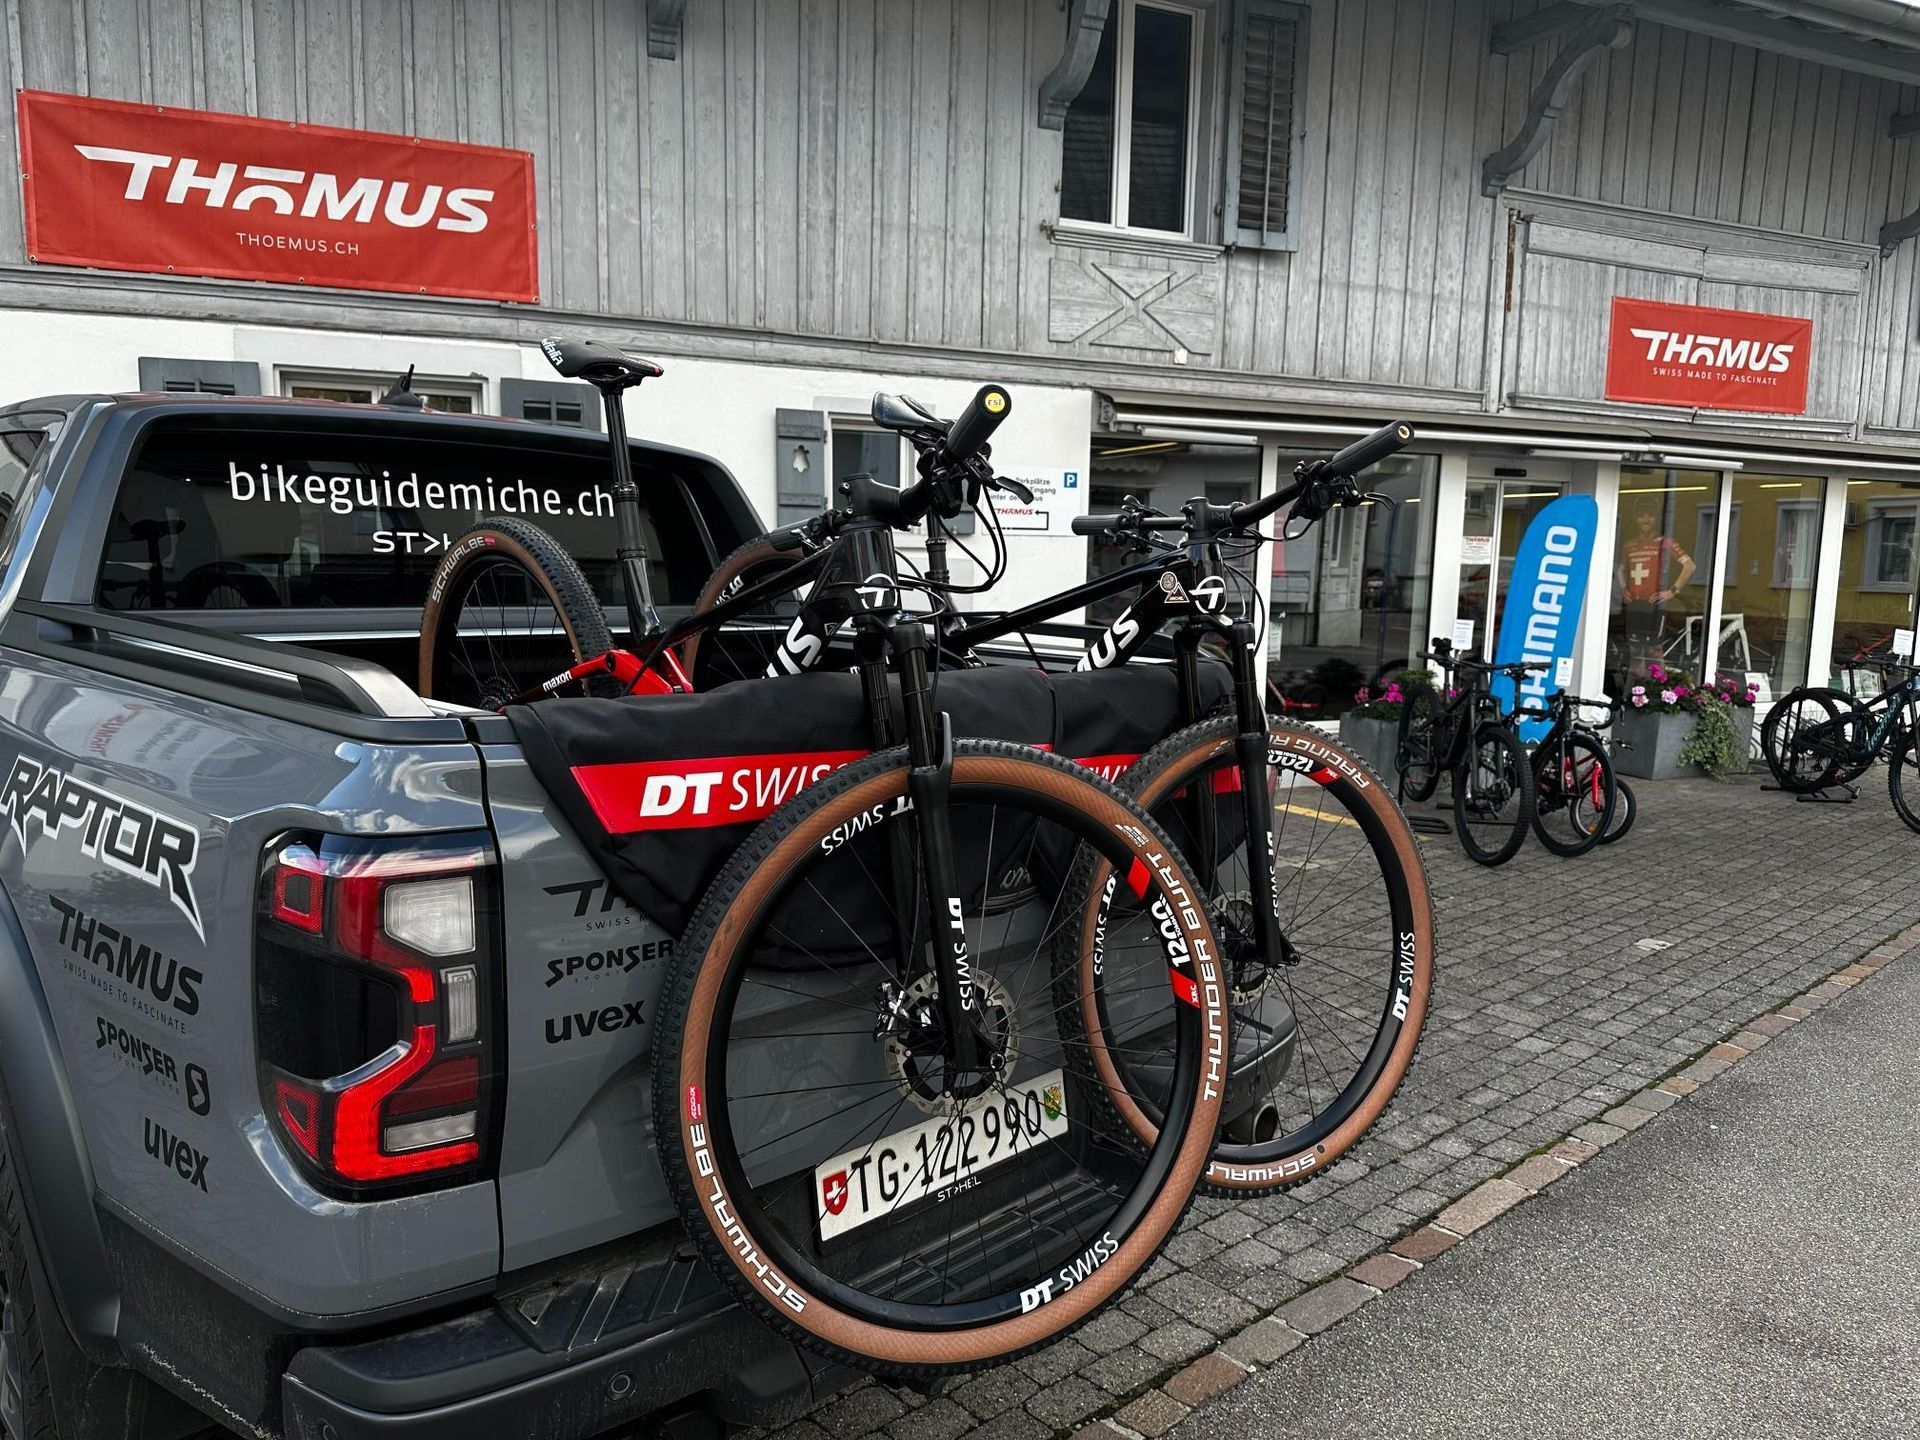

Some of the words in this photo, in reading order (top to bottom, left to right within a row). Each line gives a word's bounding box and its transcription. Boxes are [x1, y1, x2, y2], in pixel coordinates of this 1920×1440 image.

[236, 232, 359, 255] THOEMUS.CH
[1652, 366, 1682, 378] SWISS
[1687, 370, 1712, 381] MADE
[1716, 372, 1727, 382] TO
[1730, 374, 1778, 386] FASCINATE
[229, 461, 614, 518] bikeguidemiche.ch
[432, 536, 486, 604] SCHWALBE
[543, 670, 573, 692] maxon
[1293, 738, 1370, 788] RACING
[639, 772, 723, 817] DT
[0, 753, 206, 948] RAPTOR
[821, 805, 884, 856] SWISS
[948, 898, 965, 934] DT
[1146, 852, 1202, 932] BURT
[586, 917, 631, 931] SWISS
[1094, 913, 1107, 975] SWISS
[1151, 899, 1191, 967] 1200
[545, 939, 675, 988] SPONSER
[954, 943, 975, 1011] SWISS
[1399, 932, 1415, 987] SWISS
[63, 958, 87, 980] SWISS
[90, 974, 113, 995] MADE
[117, 988, 128, 1004] TO
[132, 997, 186, 1035] FASCINATE
[545, 1000, 646, 1044] uvex
[1194, 938, 1222, 1100] THUNDER
[1392, 987, 1410, 1021] DT
[96, 1016, 178, 1082] SPONSER
[144, 1117, 209, 1193] uvex
[689, 1124, 807, 1313] SCHWALBE
[1020, 1278, 1054, 1314] DT
[1059, 1231, 1119, 1292] SWISS
